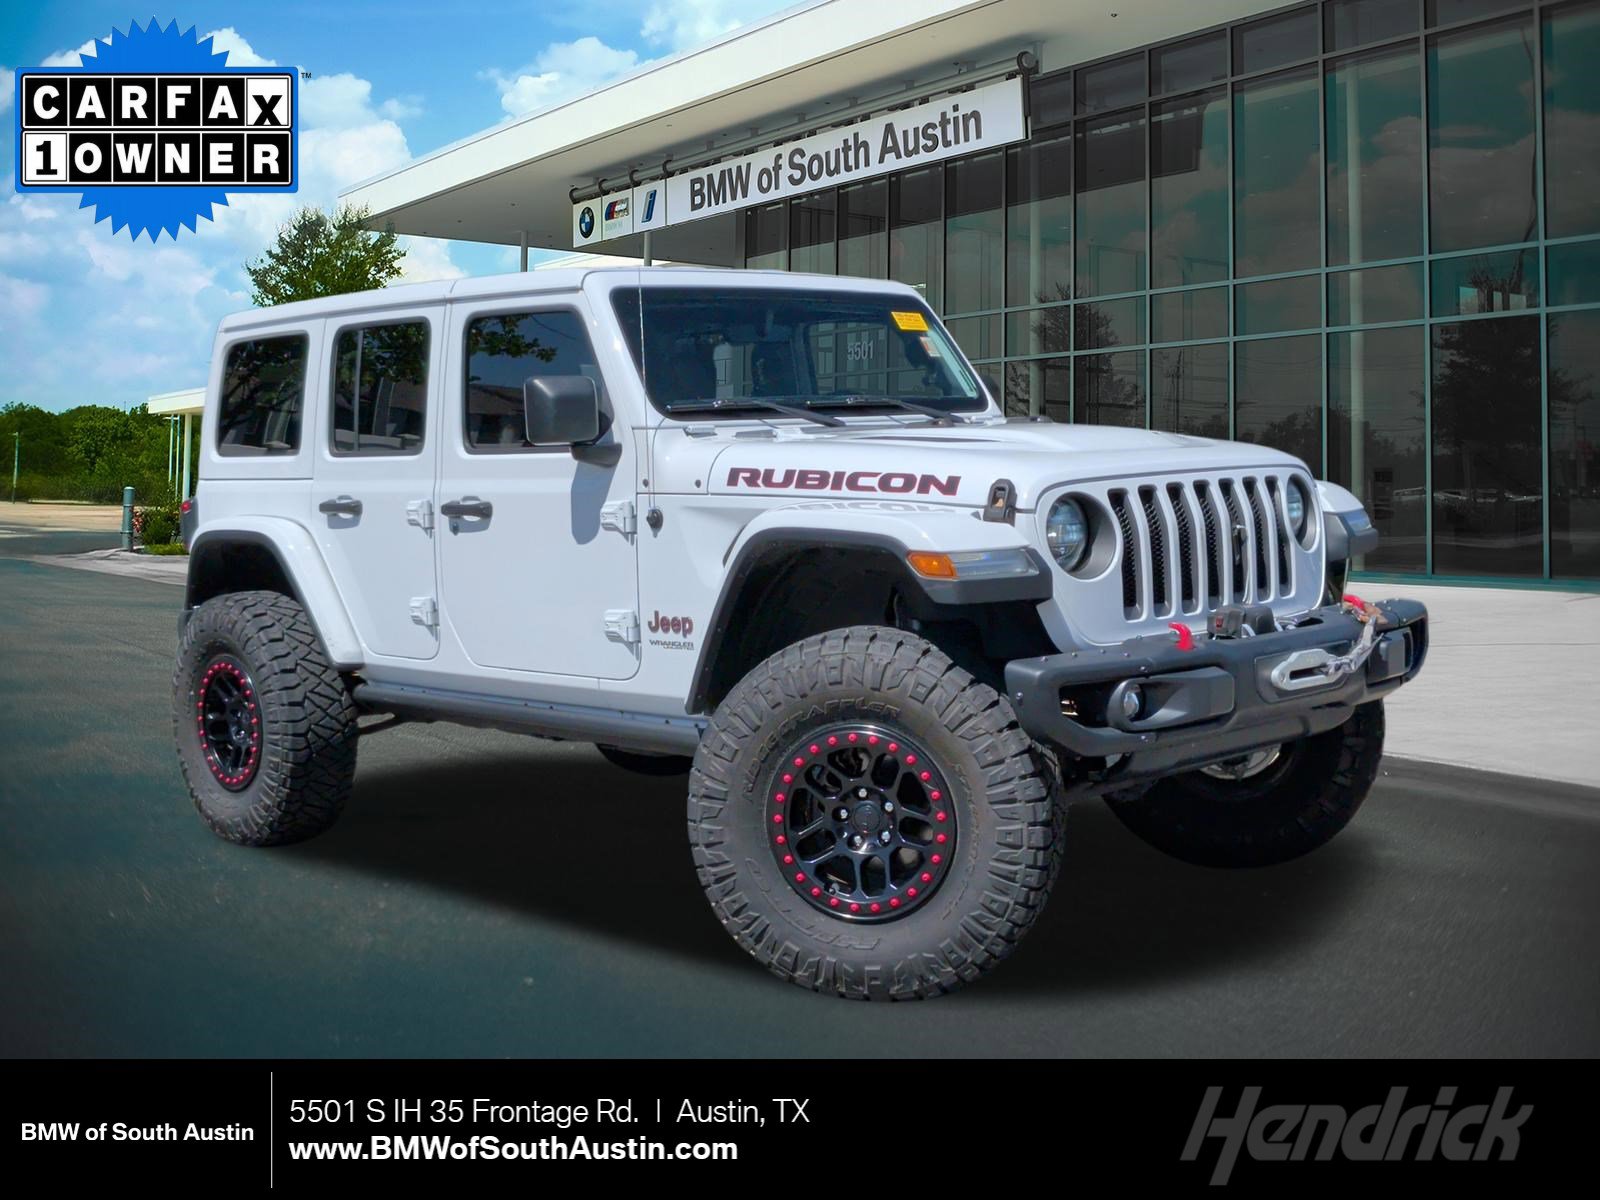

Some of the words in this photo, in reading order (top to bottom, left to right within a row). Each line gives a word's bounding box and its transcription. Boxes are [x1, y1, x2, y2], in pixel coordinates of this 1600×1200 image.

[690, 162, 752, 212] BMW
[757, 153, 783, 195] of
[787, 131, 870, 187] South
[878, 103, 982, 165] Austin
[726, 467, 961, 496] RUBICON
[648, 609, 694, 639] Jeep
